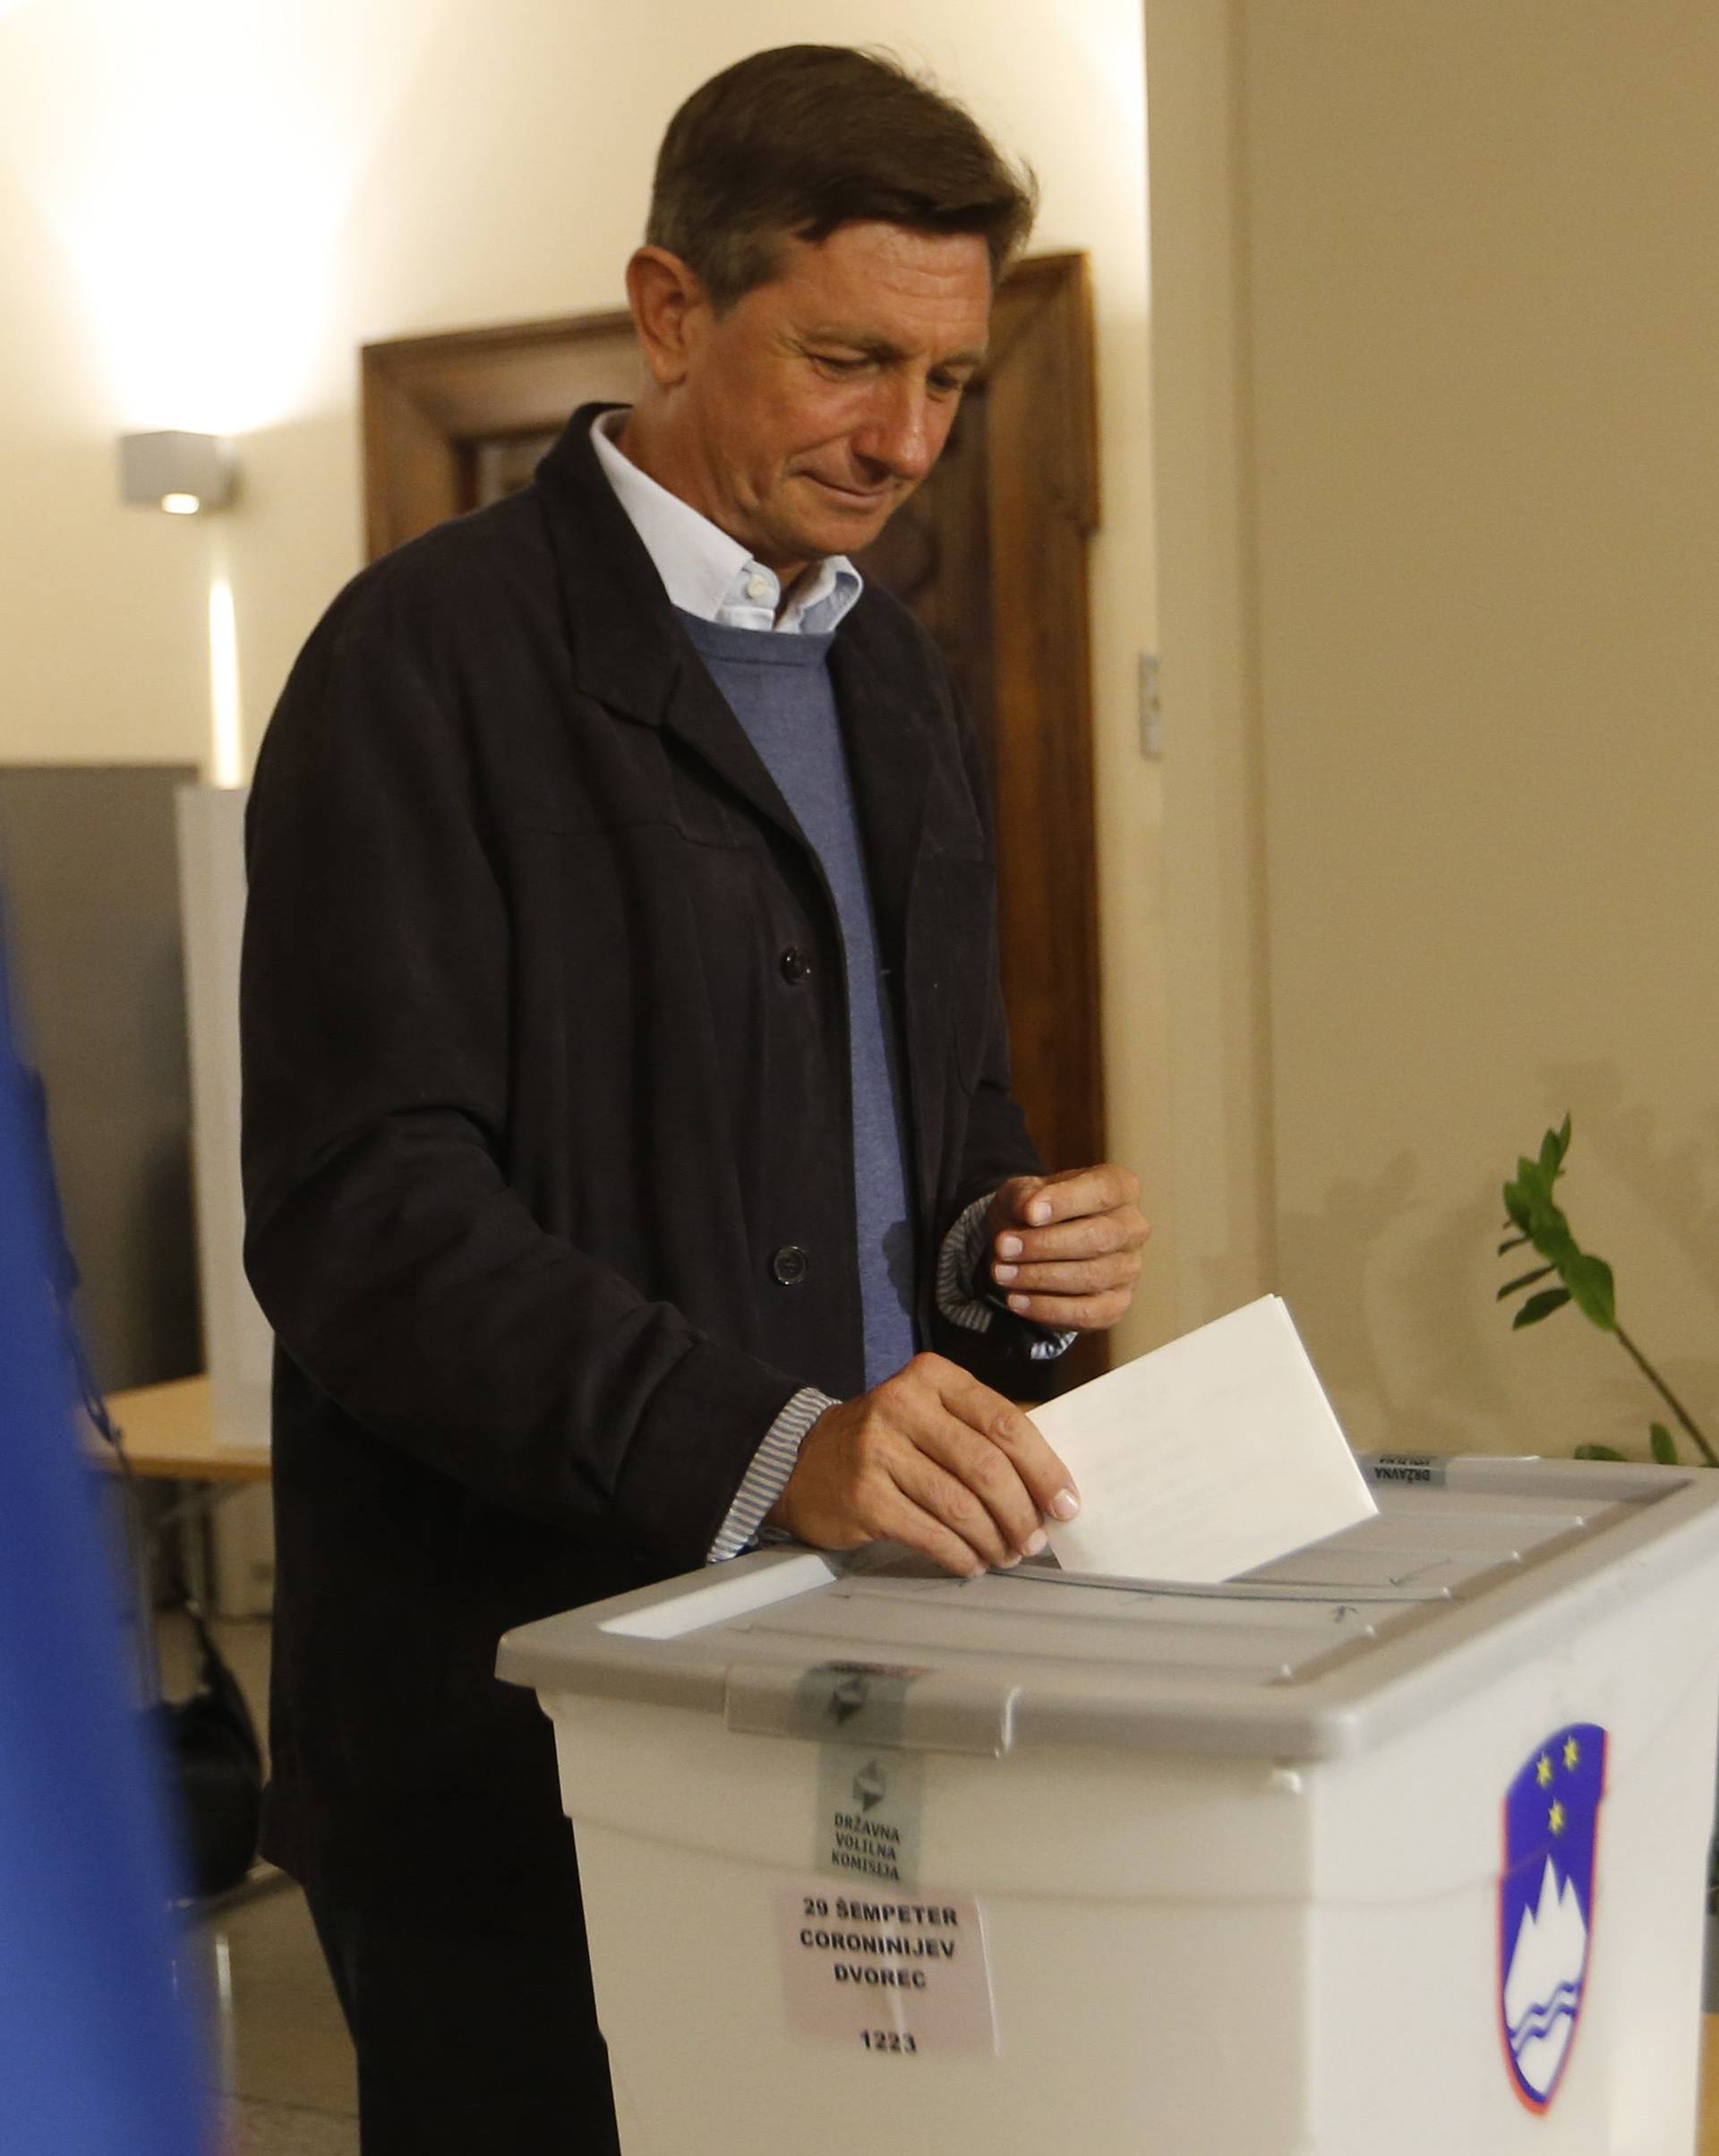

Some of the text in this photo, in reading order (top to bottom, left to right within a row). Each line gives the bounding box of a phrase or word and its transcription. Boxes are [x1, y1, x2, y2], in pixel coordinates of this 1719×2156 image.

[835, 1813, 900, 1843] DRŽAVNA
[835, 1832, 896, 1861] VOLILNA
[832, 1851, 899, 1880] KOMISIJA
[836, 1897, 957, 1926] ŠEMPETER
[800, 1929, 954, 1958] CORONINIJEV
[834, 1964, 926, 1989] DVOREC
[861, 2030, 917, 2053] 1223
